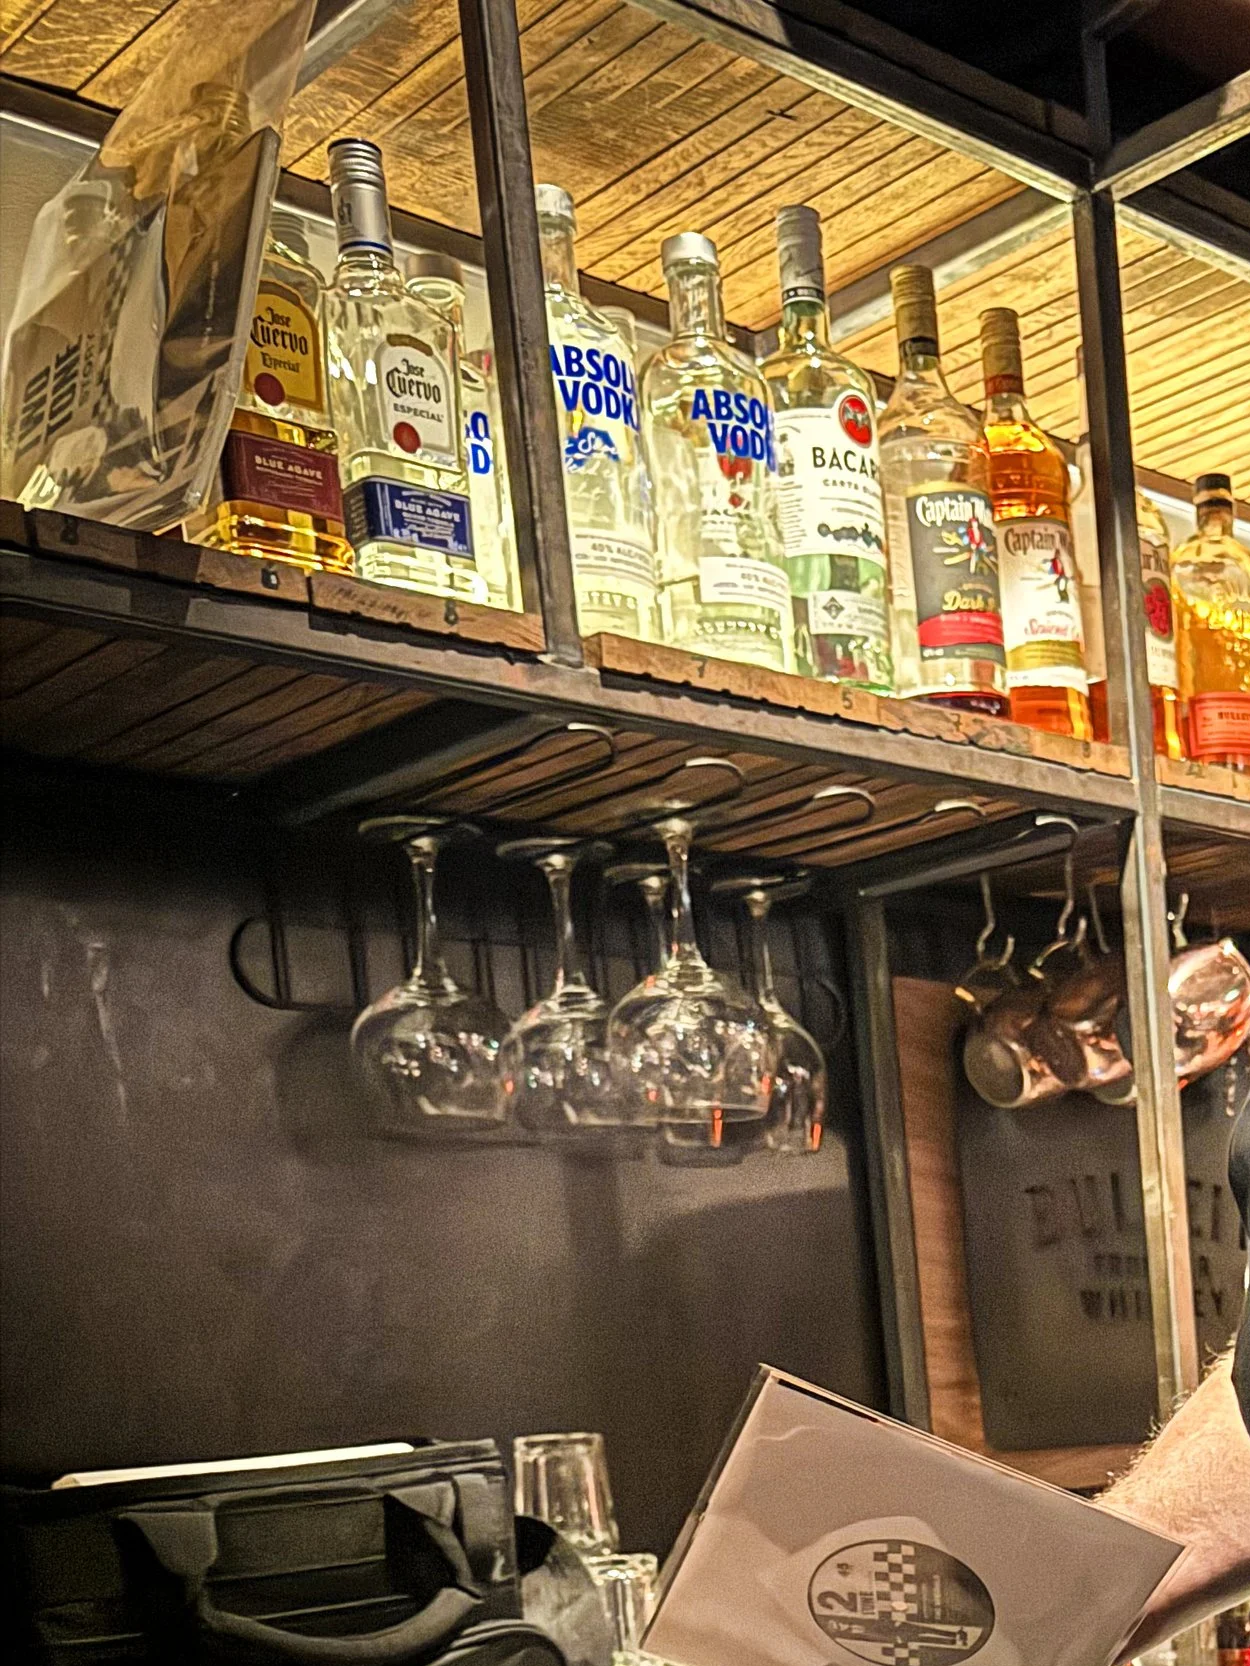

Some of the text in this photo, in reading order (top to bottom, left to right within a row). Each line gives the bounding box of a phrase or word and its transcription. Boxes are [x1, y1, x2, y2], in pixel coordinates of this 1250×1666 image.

[265, 307, 291, 328] Jose
[250, 315, 309, 356] Cuervo
[401, 358, 425, 378] Jose
[386, 367, 442, 404] Cuervo
[393, 403, 443, 423] ESPECIAL
[254, 455, 285, 471] BLUE
[394, 499, 460, 523] BLUE AGAVE
[915, 494, 974, 527] Captain
[1004, 527, 1056, 557] Captain
[817, 1590, 858, 1613] 2
